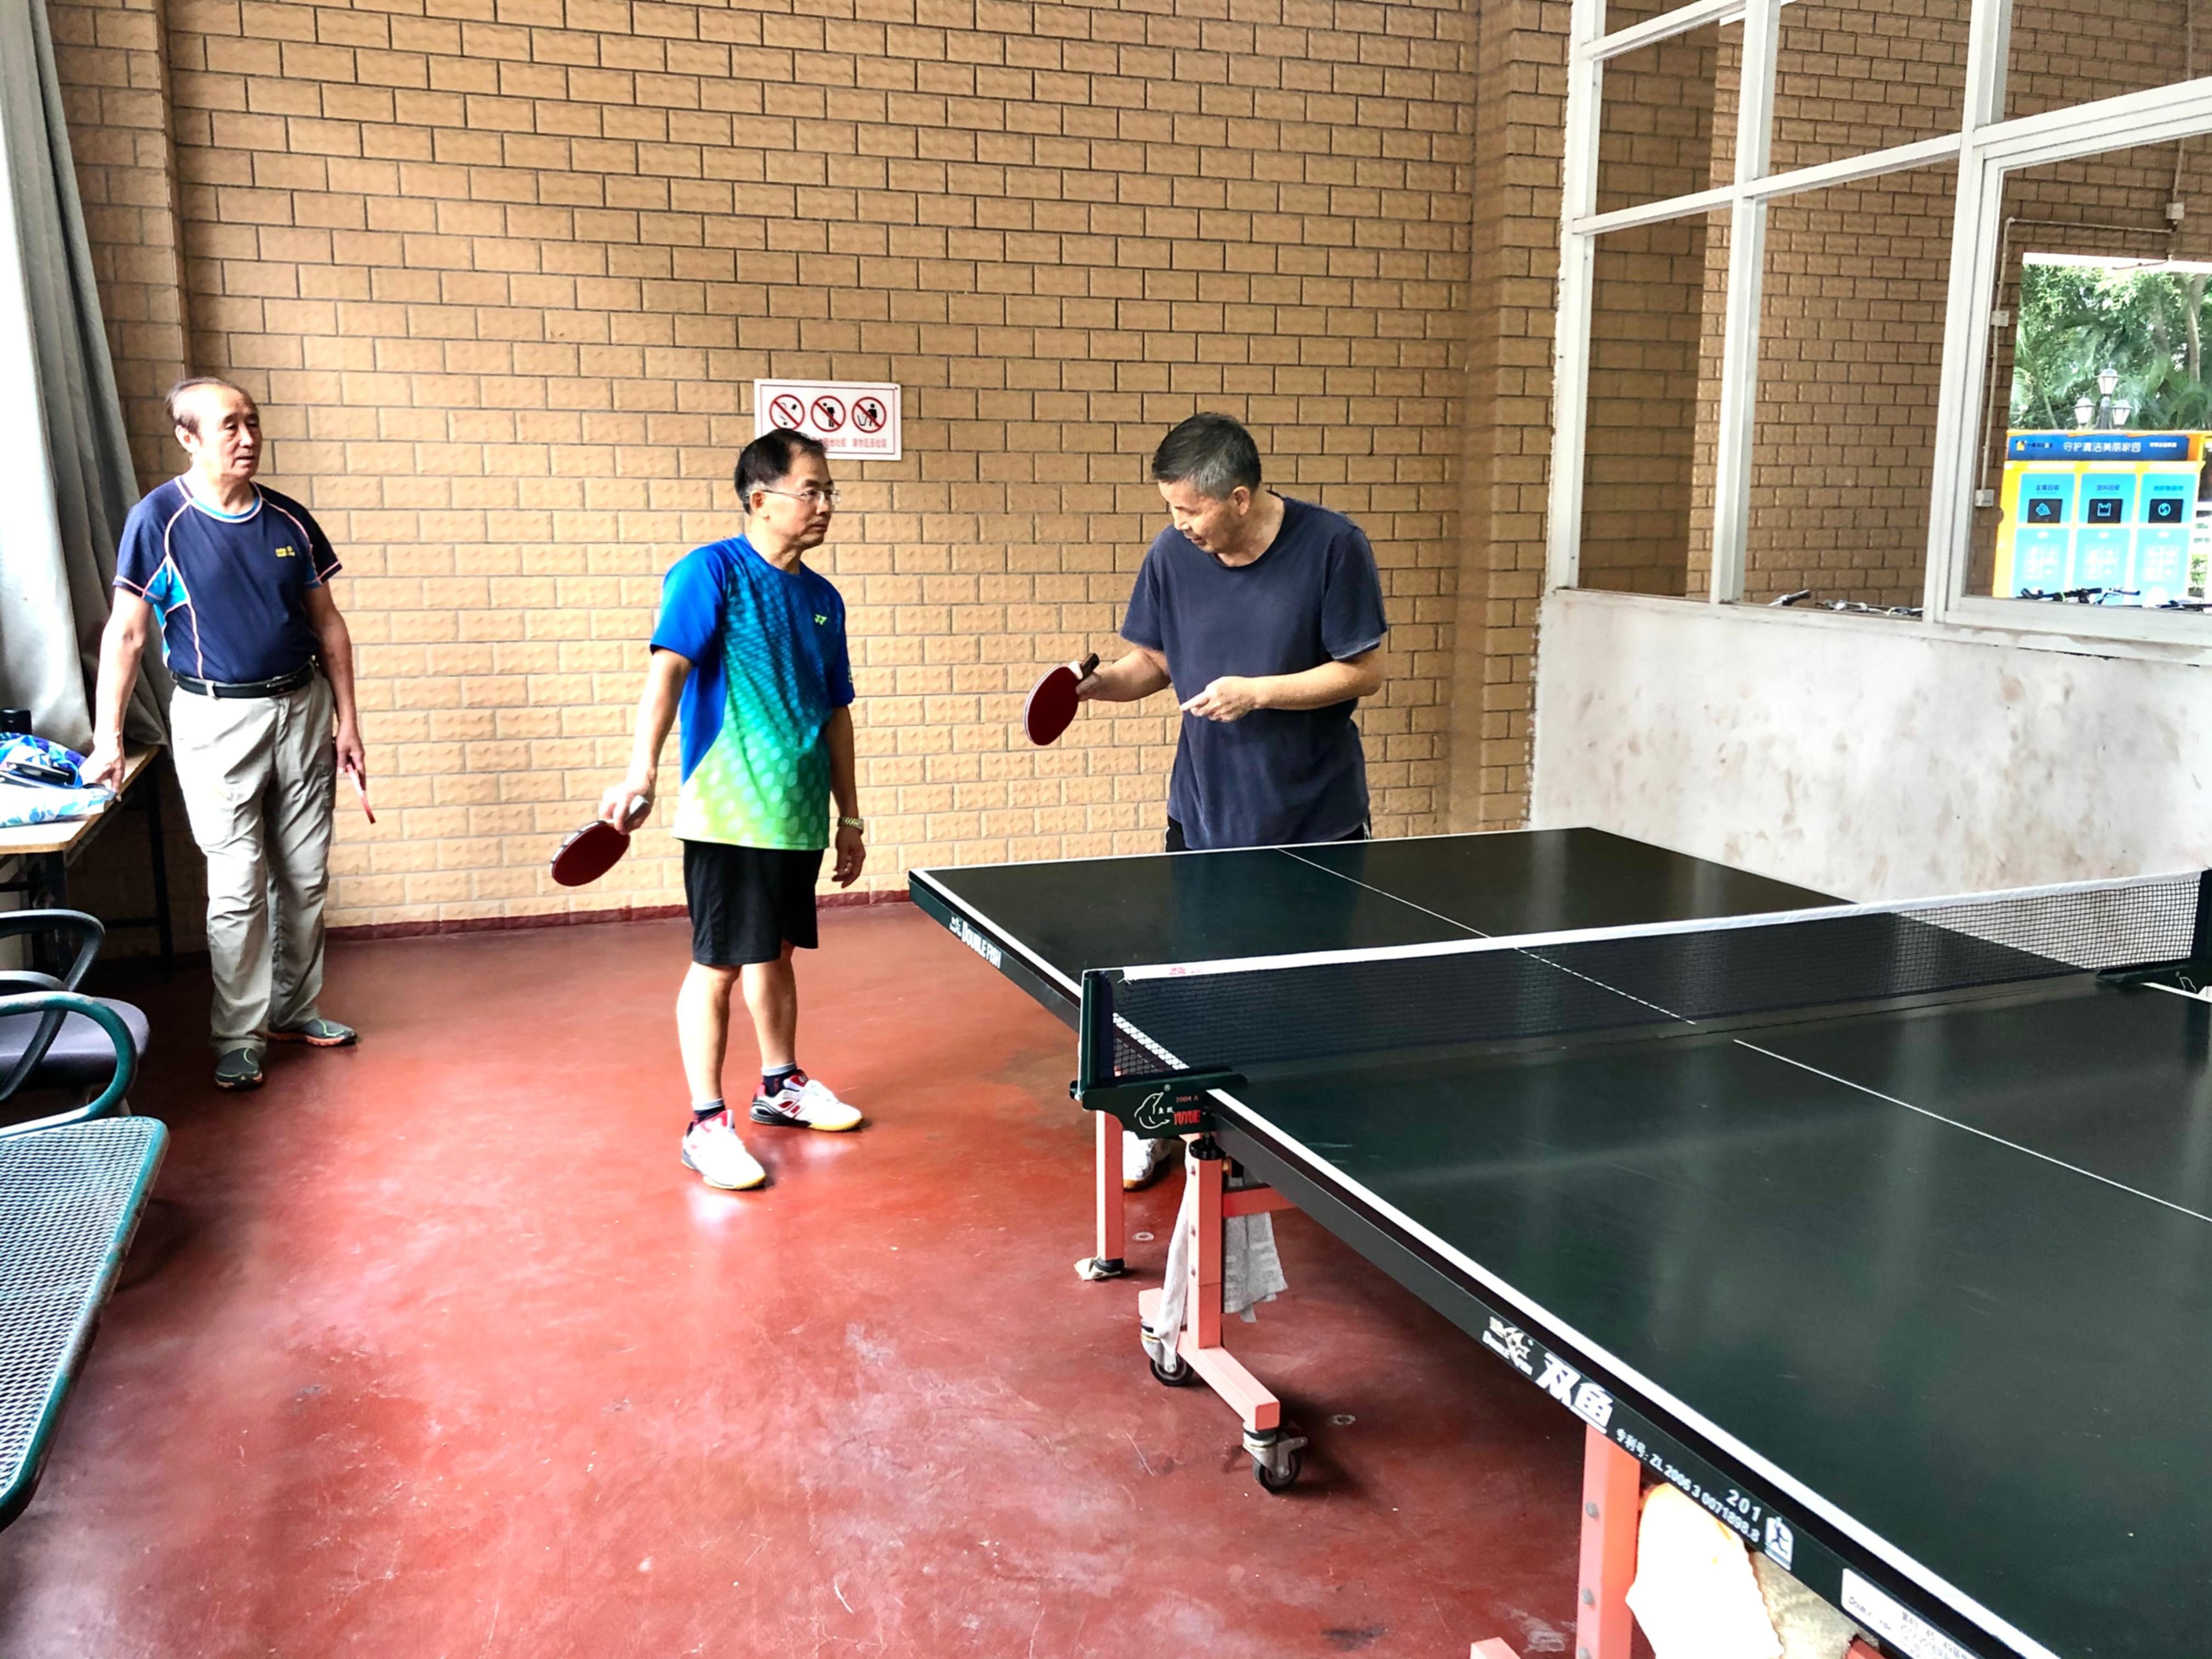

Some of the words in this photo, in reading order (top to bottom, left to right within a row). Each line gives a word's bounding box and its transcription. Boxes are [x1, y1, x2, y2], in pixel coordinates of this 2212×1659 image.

[2063, 442, 2141, 453] 守护清洁美丽家园
[1536, 1353, 1613, 1434] 双鱼
[1691, 1485, 1701, 1498] 3
[1726, 1489, 1762, 1522] 201
